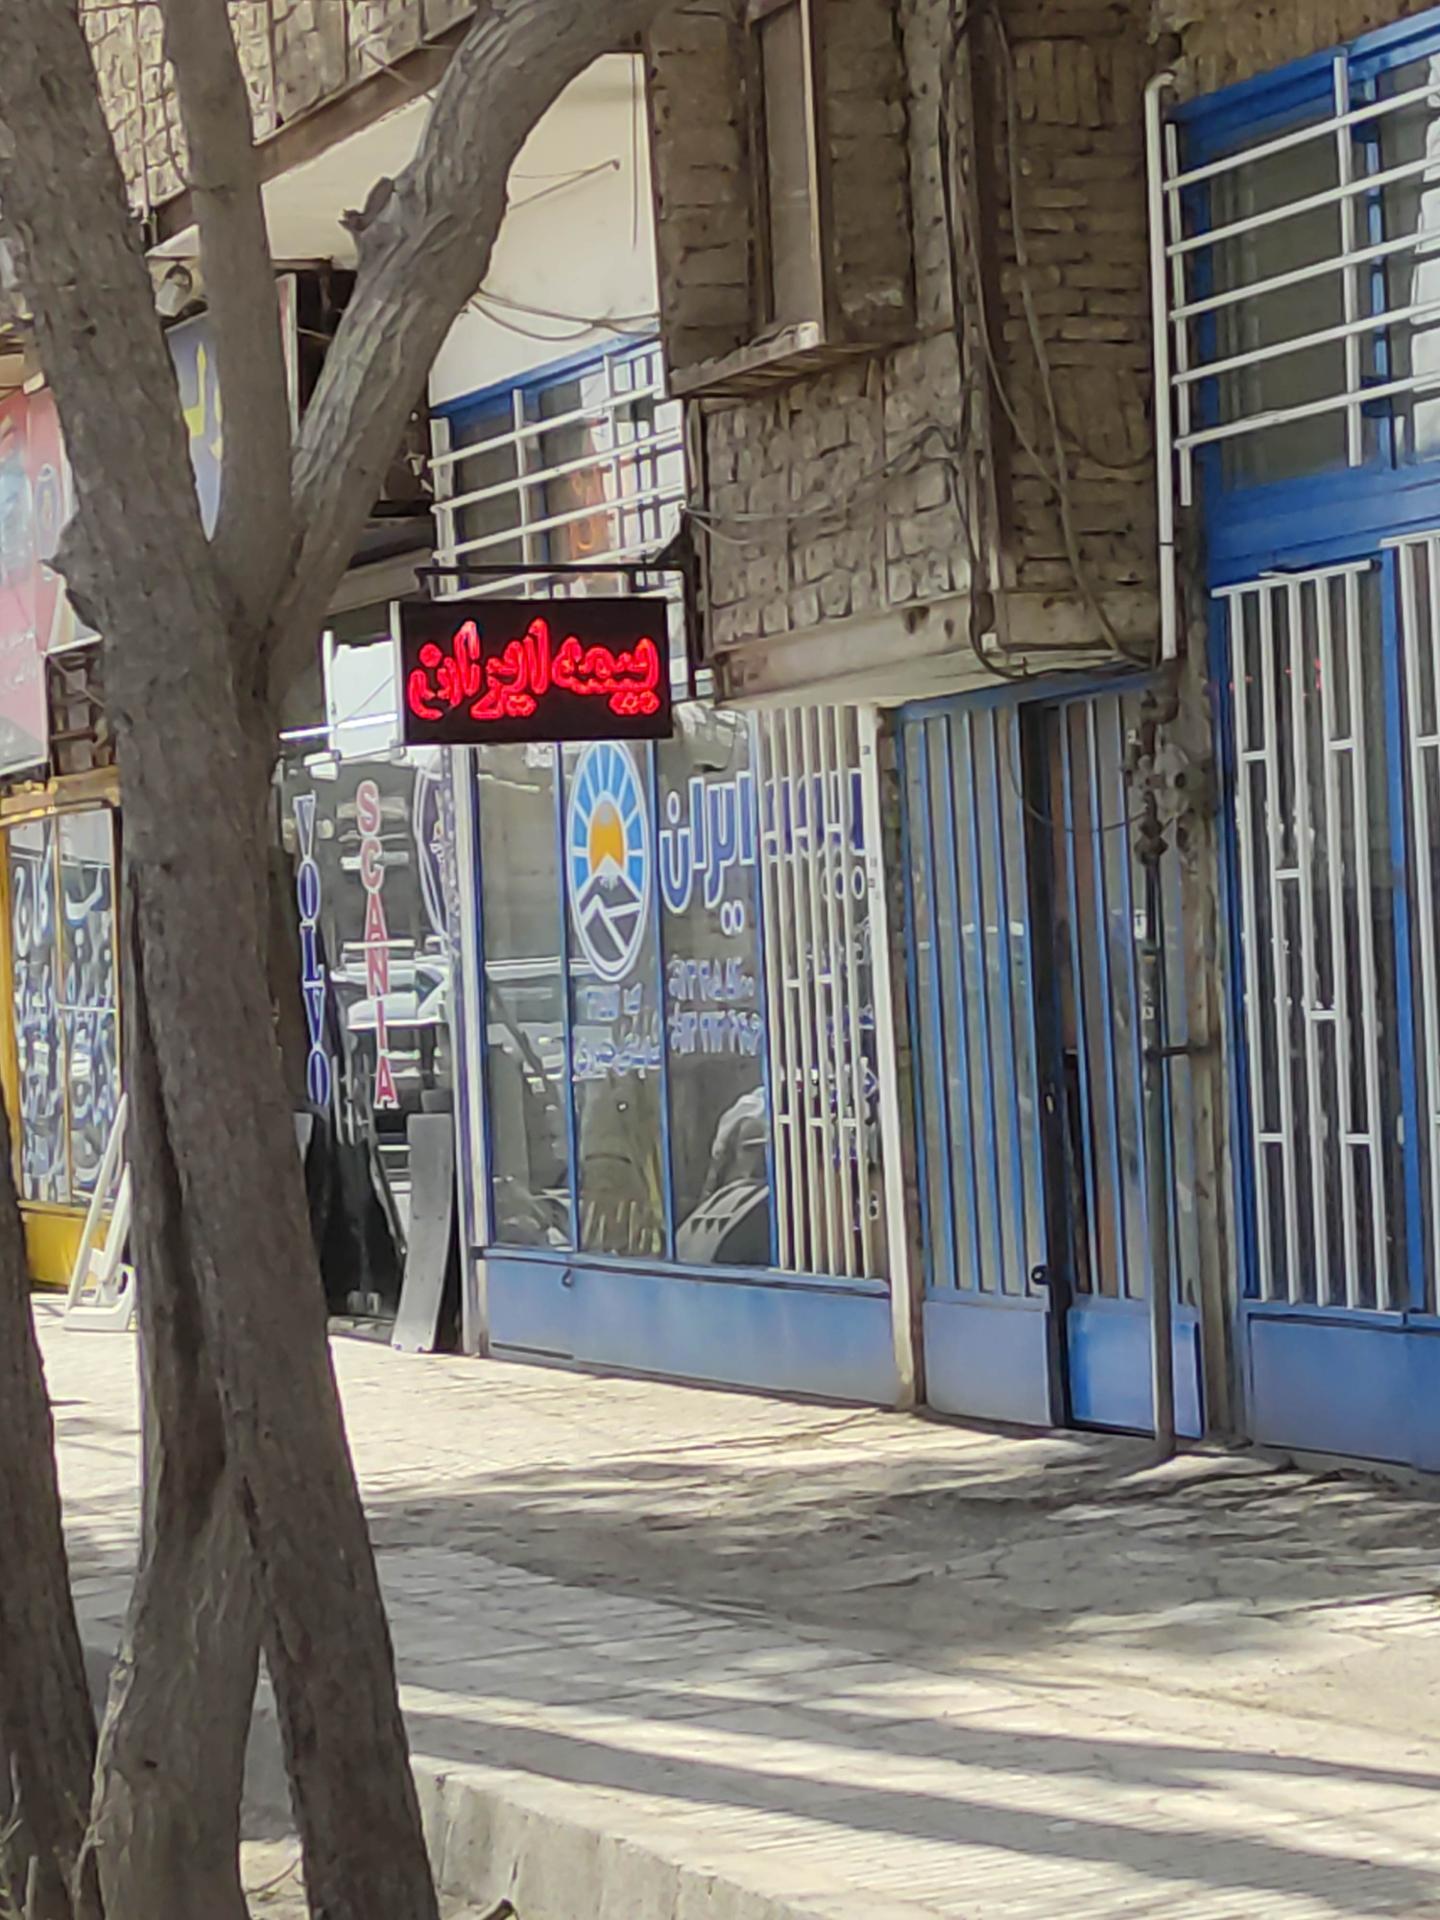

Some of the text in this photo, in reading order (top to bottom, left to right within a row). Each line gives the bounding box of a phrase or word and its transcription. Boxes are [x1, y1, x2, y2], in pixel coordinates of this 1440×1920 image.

[408, 616, 660, 721] بیمه ایران
[292, 790, 333, 1107] VOLVO
[355, 779, 400, 1111] SCANIA
[658, 770, 758, 936] ایران
